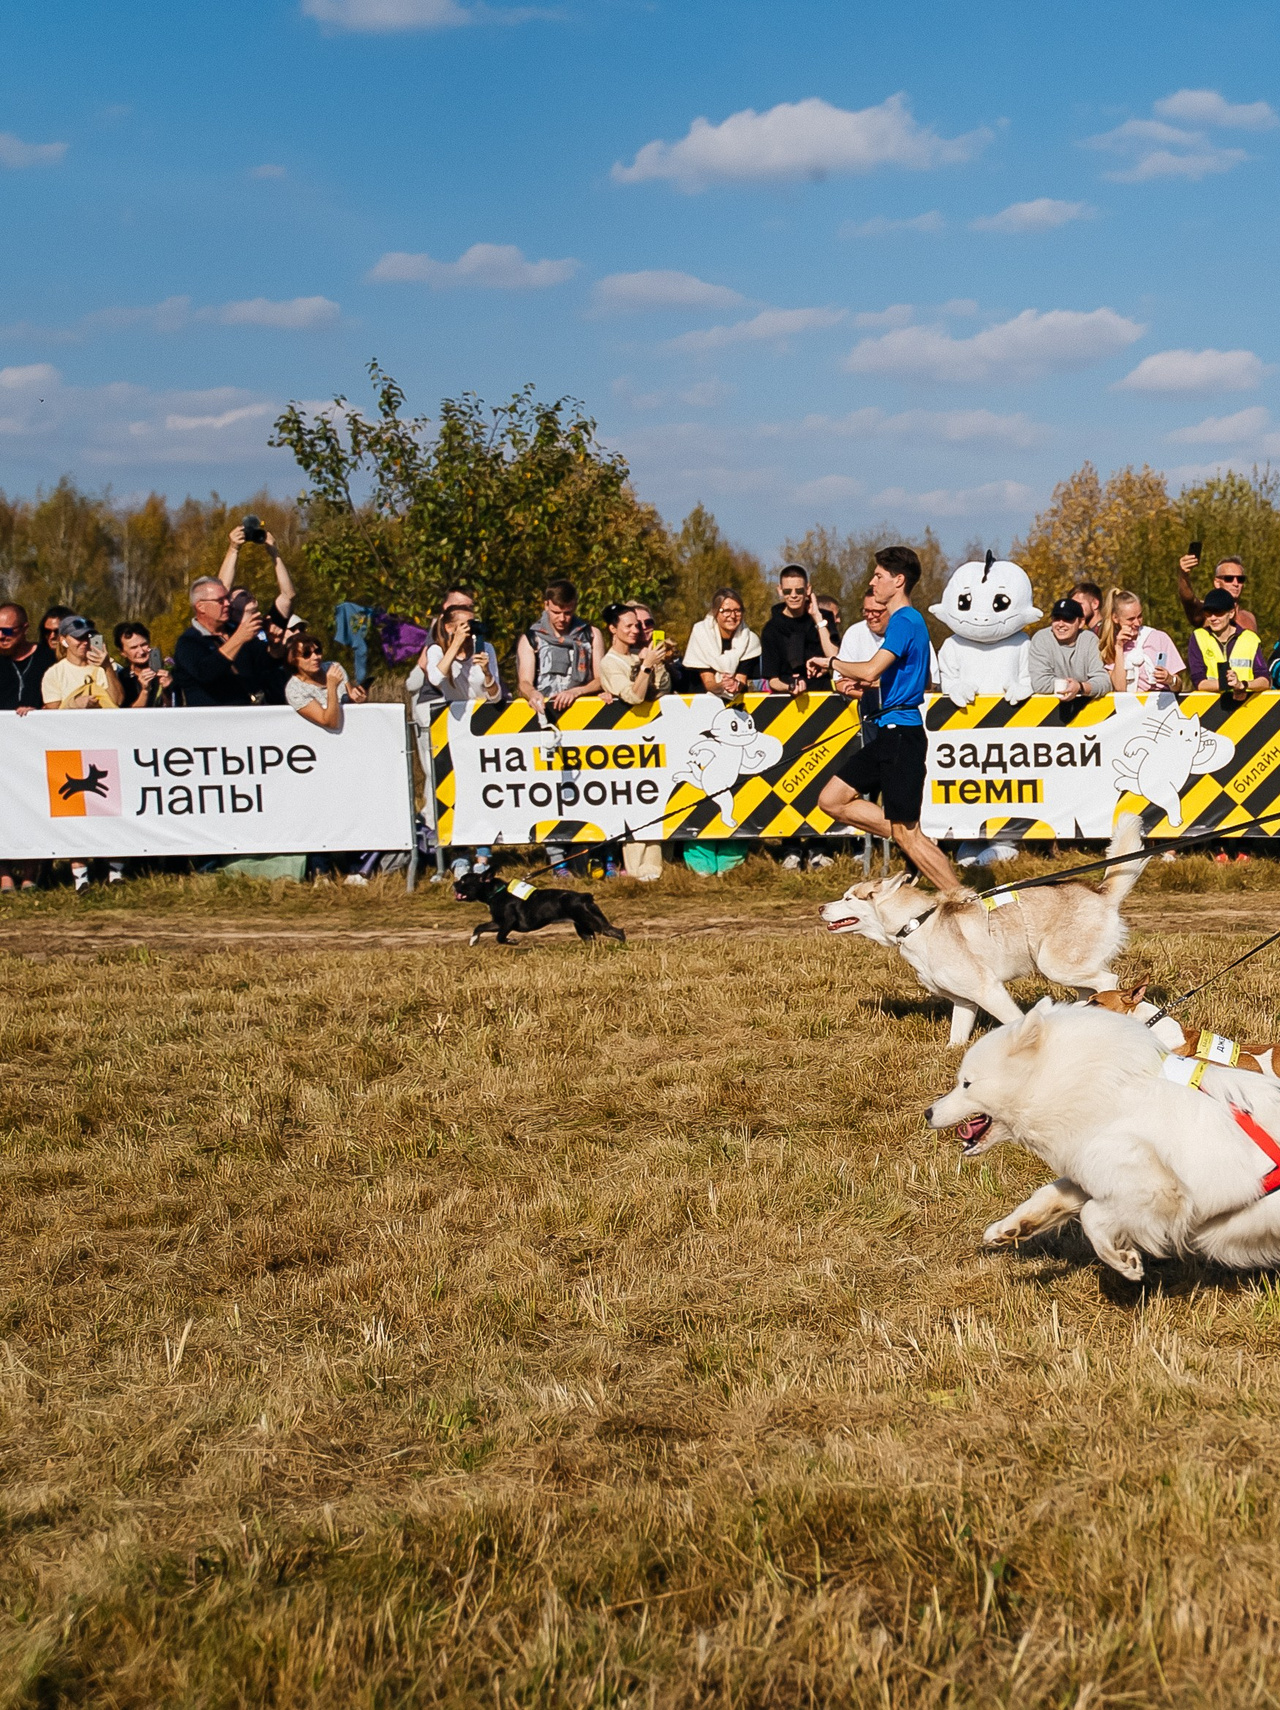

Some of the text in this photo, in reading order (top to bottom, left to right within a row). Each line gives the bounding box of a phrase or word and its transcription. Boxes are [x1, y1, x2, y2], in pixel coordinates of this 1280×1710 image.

[133, 744, 317, 777] четыре
[479, 746, 527, 773] на
[781, 745, 831, 793] билайн
[936, 734, 1102, 774] задавай
[135, 783, 264, 816] лапы
[481, 779, 660, 816] стороне
[936, 779, 1039, 804] темп
